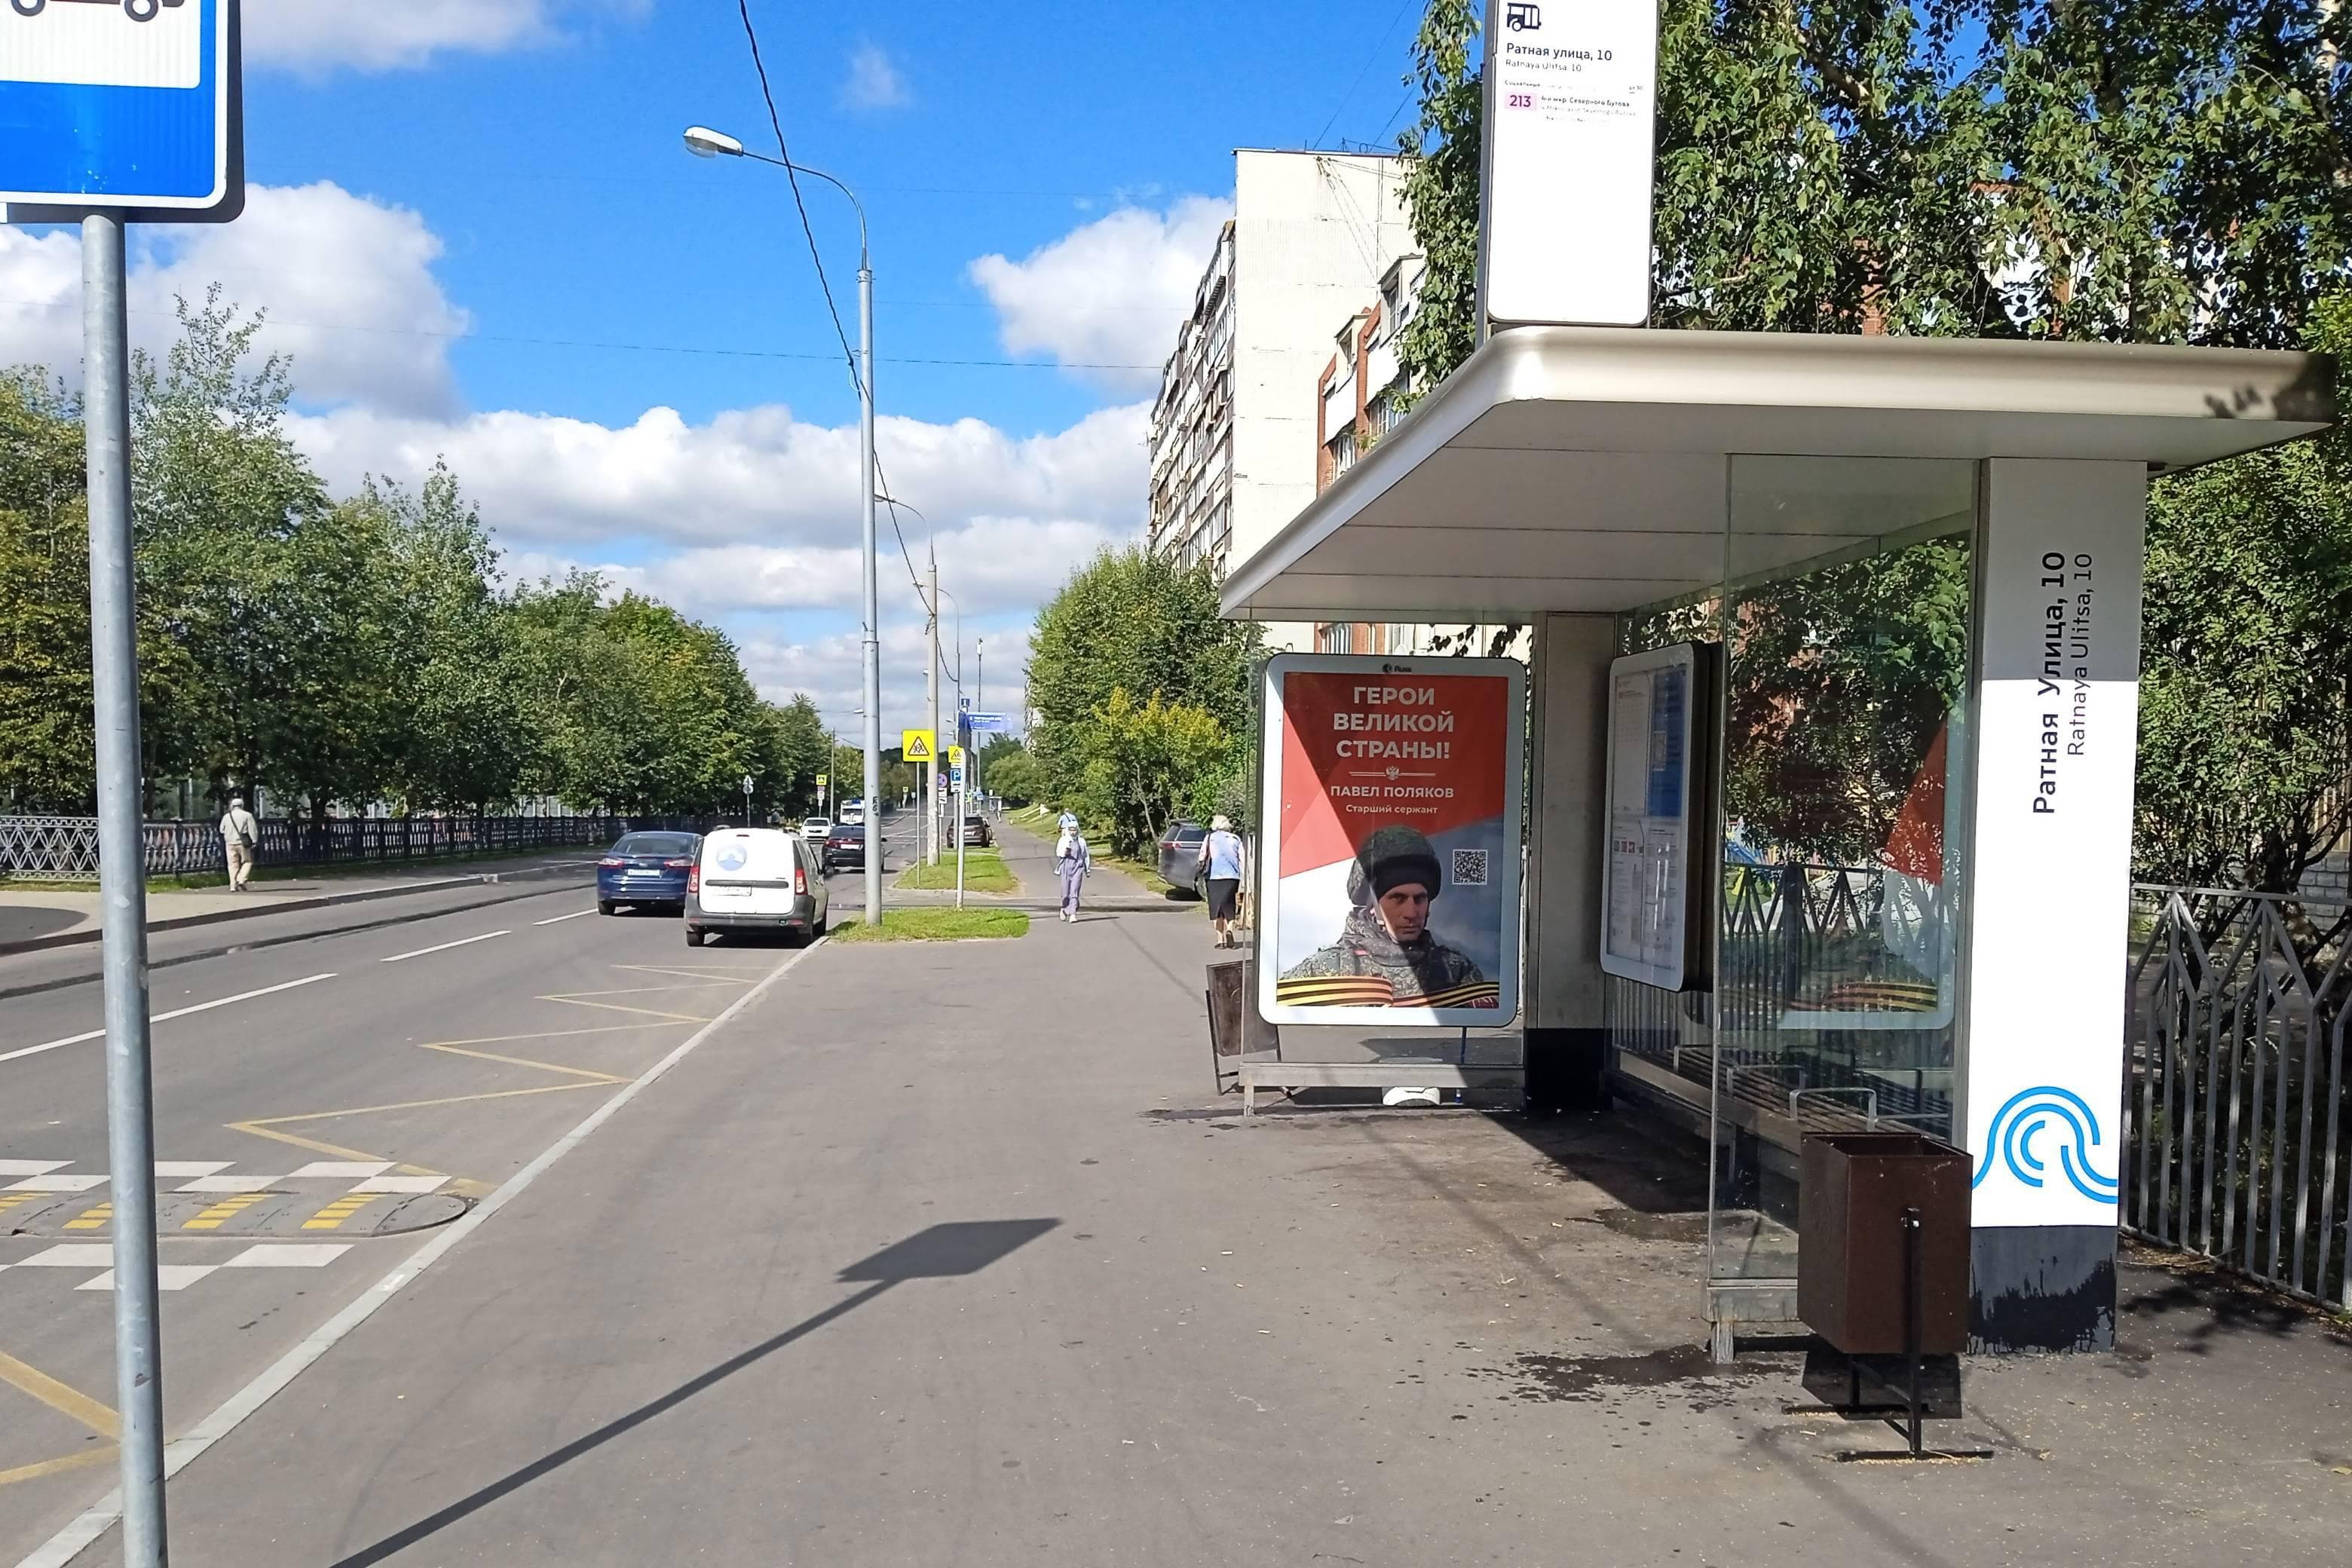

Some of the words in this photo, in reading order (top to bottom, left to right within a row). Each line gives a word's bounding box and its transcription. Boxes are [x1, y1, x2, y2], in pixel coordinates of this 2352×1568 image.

[1507, 43, 1549, 57] Ратная
[1553, 47, 1593, 61] улица,
[1597, 50, 1612, 61] 10
[1505, 60, 1539, 69] Ratnaya
[1572, 64, 1582, 72] 10
[1509, 95, 1532, 108] 213
[2041, 552, 2066, 587] 10
[2074, 553, 2092, 580] 10
[2071, 588, 2094, 658] Ulitsa,
[2038, 598, 2068, 696] Улица,
[1353, 687, 1435, 706] ГЕРОИ
[2068, 666, 2090, 755] Ratnaya
[1334, 711, 1454, 733] ВЕЛИКОЙ
[1336, 740, 1450, 759] СТРАНЫ!
[2032, 714, 2059, 813] Ратная
[1331, 786, 1380, 798] ПАВЕЛ
[1384, 786, 1454, 798] ПОЛЯКОВ
[1346, 804, 1392, 814] Старший
[1395, 805, 1438, 816] сержант
